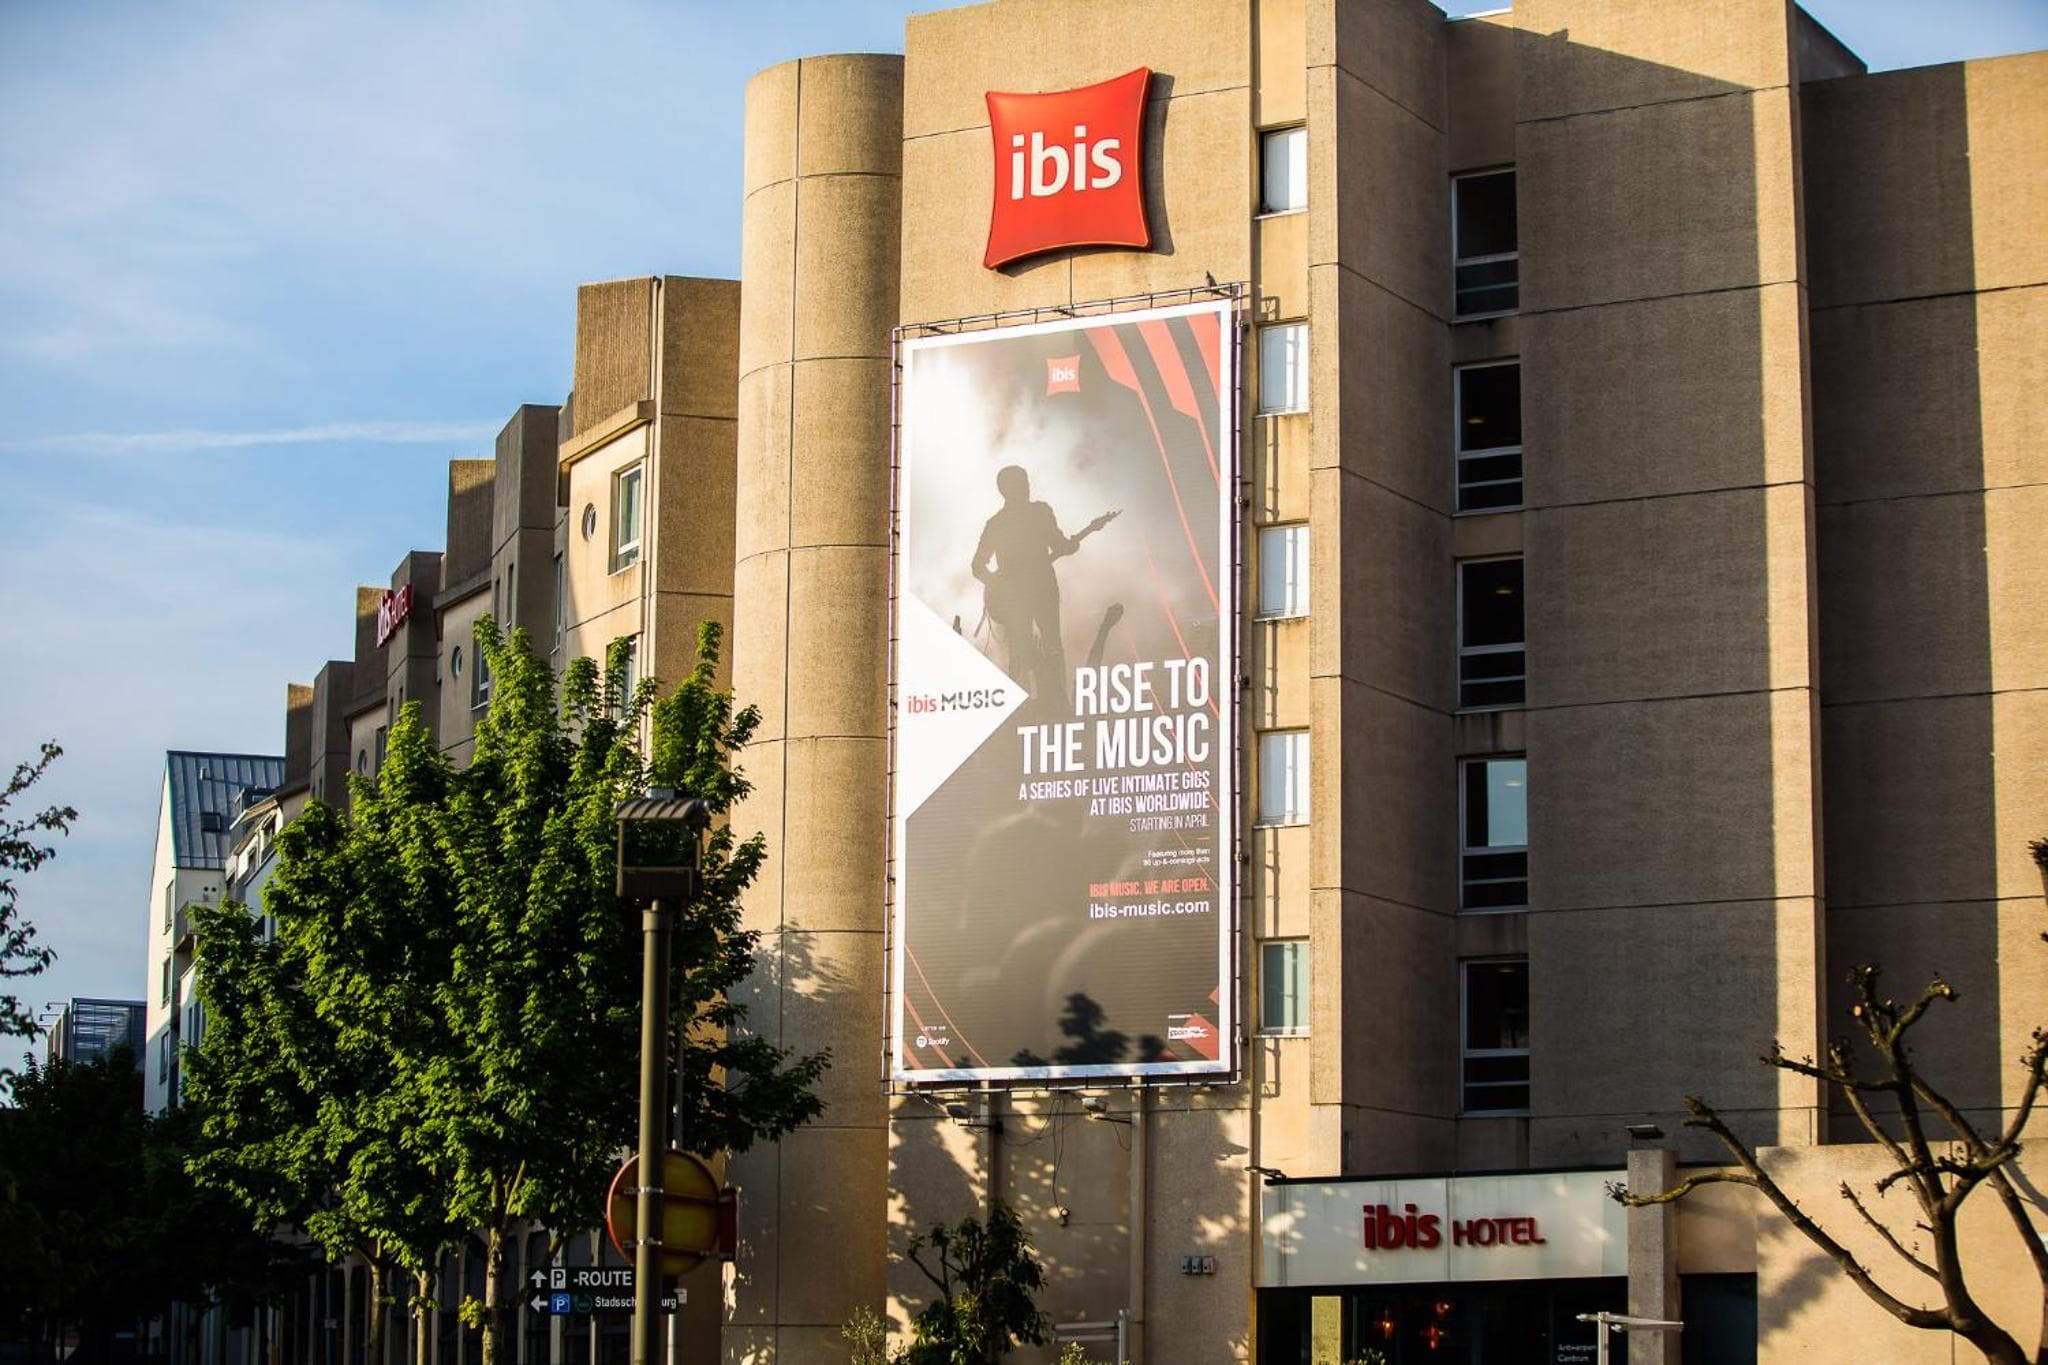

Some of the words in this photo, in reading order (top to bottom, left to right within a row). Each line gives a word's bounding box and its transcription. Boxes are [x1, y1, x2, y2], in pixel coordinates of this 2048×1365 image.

[1010, 124, 1123, 201] ibis
[1075, 661, 1154, 717] RISE
[1164, 656, 1209, 709] TO
[907, 694, 938, 714] ibis
[941, 688, 1005, 712] MUSIC
[1017, 722, 1085, 775] THE
[1095, 712, 1209, 770] MUSIC
[1018, 783, 1028, 800] A
[1029, 780, 1071, 800] SERIES
[1074, 779, 1090, 797] OF
[1092, 776, 1119, 796] LIVE
[1121, 773, 1180, 794] INTIMATE
[1182, 771, 1210, 790] GIGS
[1090, 799, 1106, 816] AT
[1109, 796, 1133, 815] IBIS
[1135, 791, 1210, 813] WORLDWIDE
[1129, 815, 1174, 833] STARTING
[1144, 879, 1159, 895] WE
[1161, 879, 1180, 894] ARE
[1090, 900, 1210, 919] ibis-music.com
[1363, 1203, 1442, 1250] ibis
[1452, 1217, 1546, 1247] HOTEL
